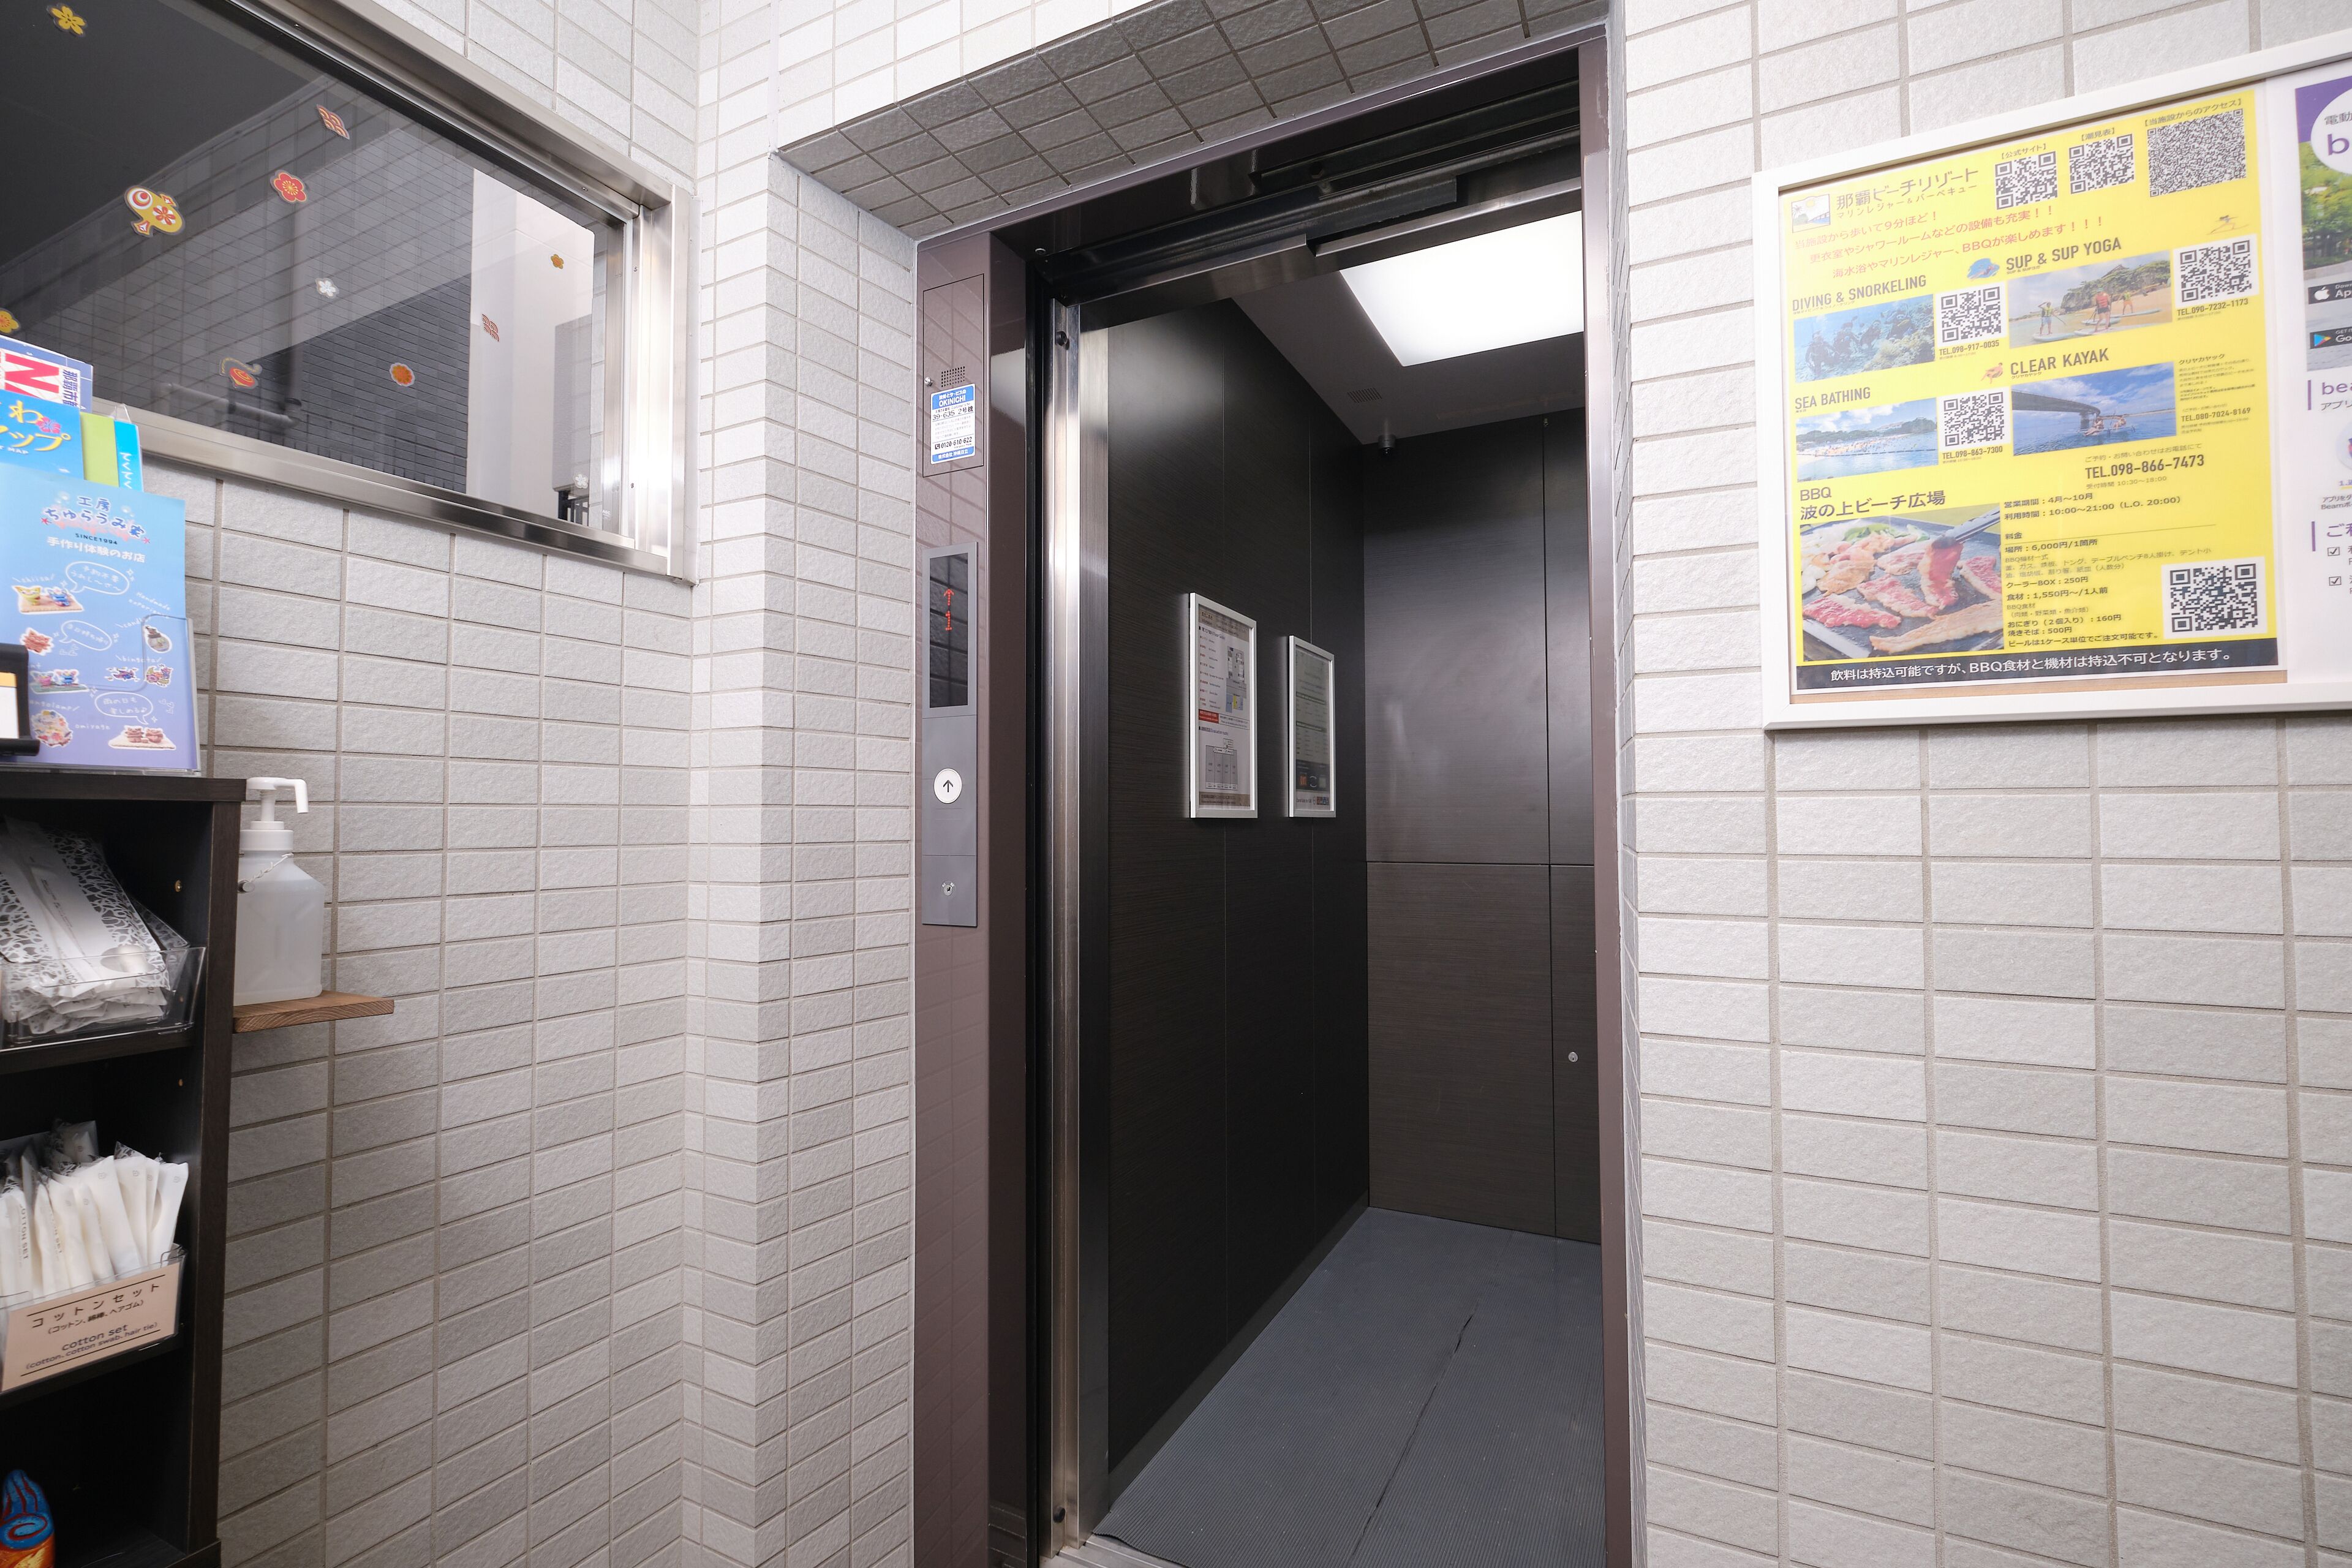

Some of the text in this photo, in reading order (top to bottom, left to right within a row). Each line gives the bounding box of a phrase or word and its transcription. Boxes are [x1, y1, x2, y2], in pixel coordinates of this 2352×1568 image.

[2002, 143, 2046, 159] 【公式サイト】
[1836, 168, 1978, 210] 那覇ビーチリゾート
[2006, 237, 2121, 270] SUP & SUP YOGA
[1793, 274, 1926, 311] DIVING & SNORKELING
[2010, 348, 2109, 375] CLEAR KAYAK
[939, 394, 966, 407] OKINICHI
[1795, 386, 1871, 409] SEA BATHING
[2085, 454, 2205, 480] TEL.098-866-7473
[1800, 487, 1831, 501] BBQ
[2086, 481, 2115, 489] 受付時間
[1800, 491, 1945, 521] 波の上ビーチ広場
[47, 537, 146, 563] 手作り体験のお店
[32, 1284, 159, 1328] コットンセット
[62, 1324, 128, 1351] cotton set
